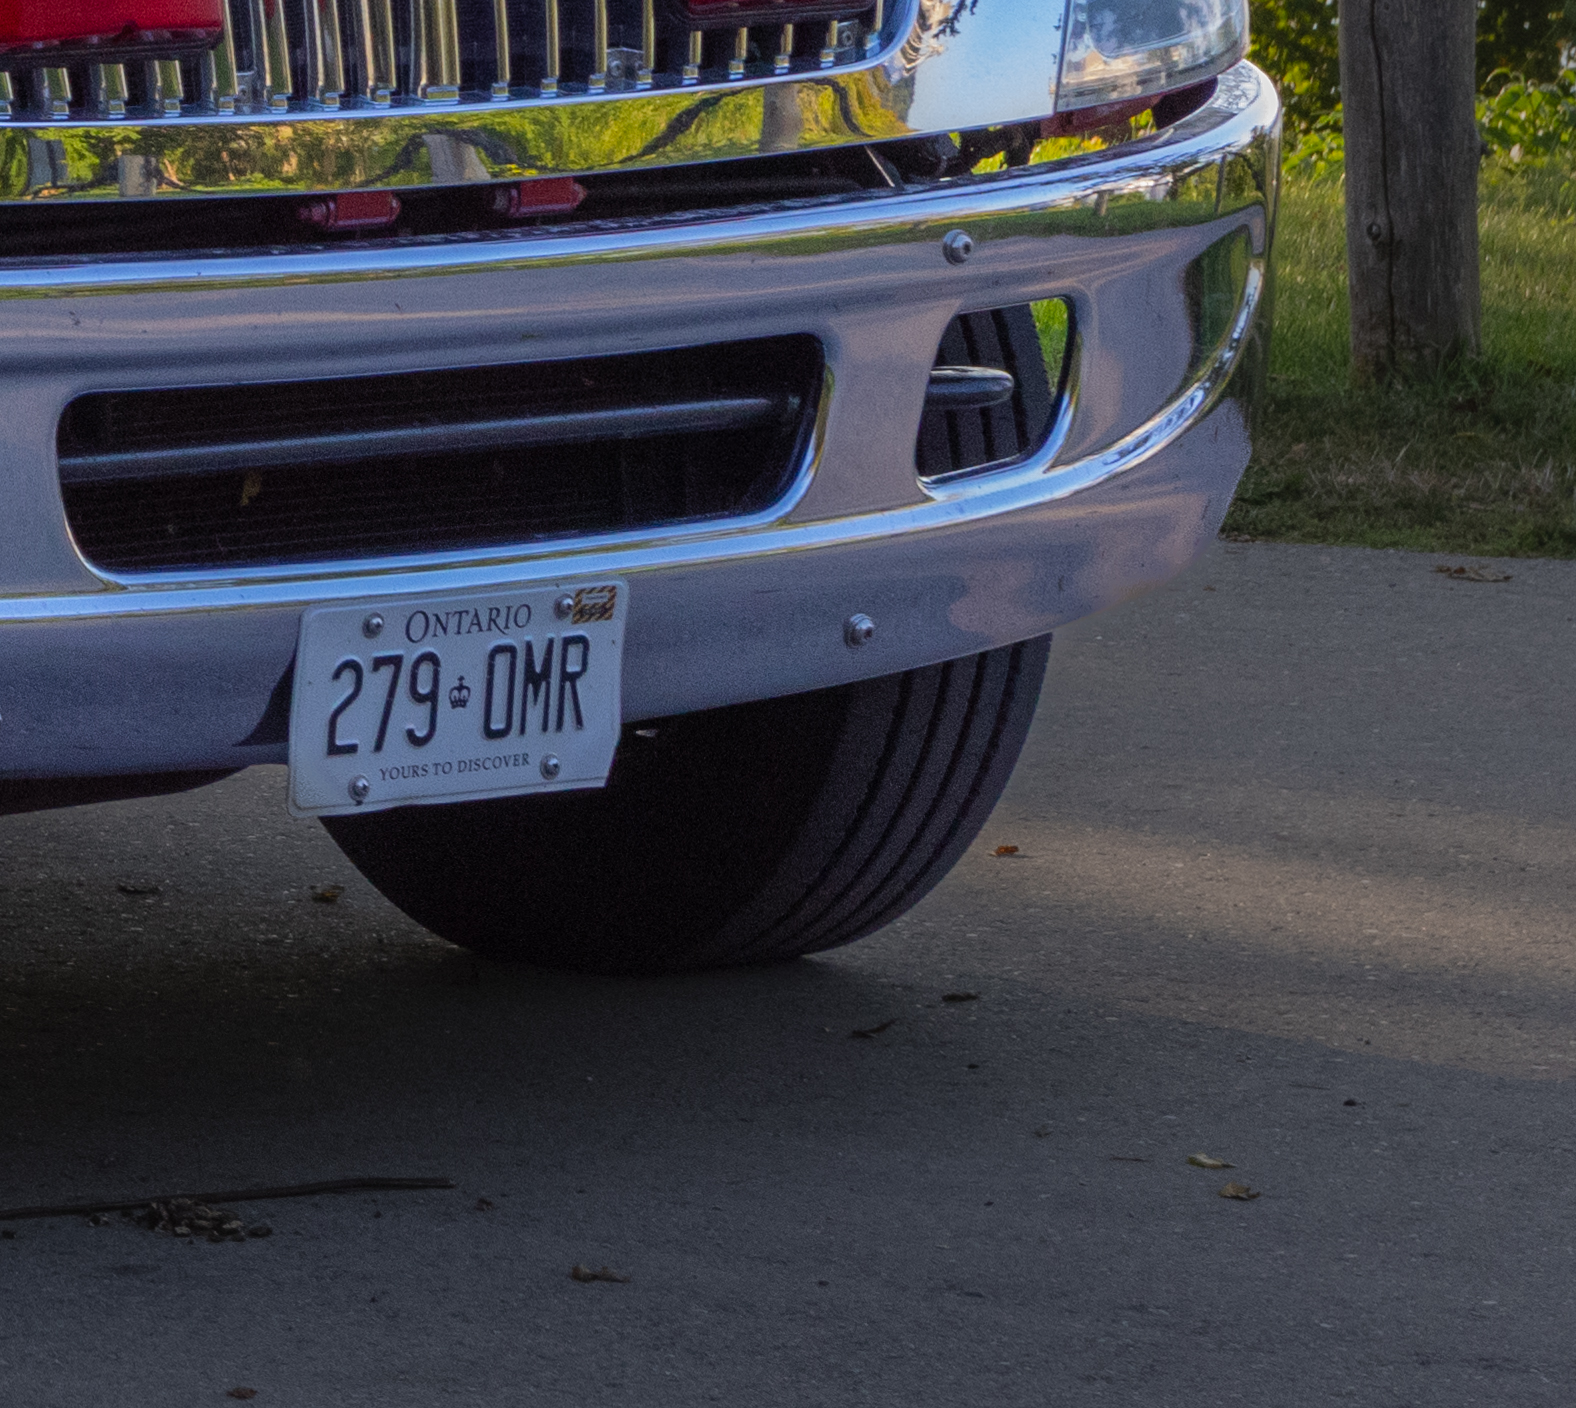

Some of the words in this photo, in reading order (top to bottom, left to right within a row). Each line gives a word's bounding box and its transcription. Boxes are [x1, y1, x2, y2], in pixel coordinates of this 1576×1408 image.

[404, 603, 533, 644] ONTARIO
[326, 650, 443, 757] 279
[379, 763, 429, 782] YOURS
[432, 761, 453, 776] TO
[457, 752, 530, 774] DISCOVER
